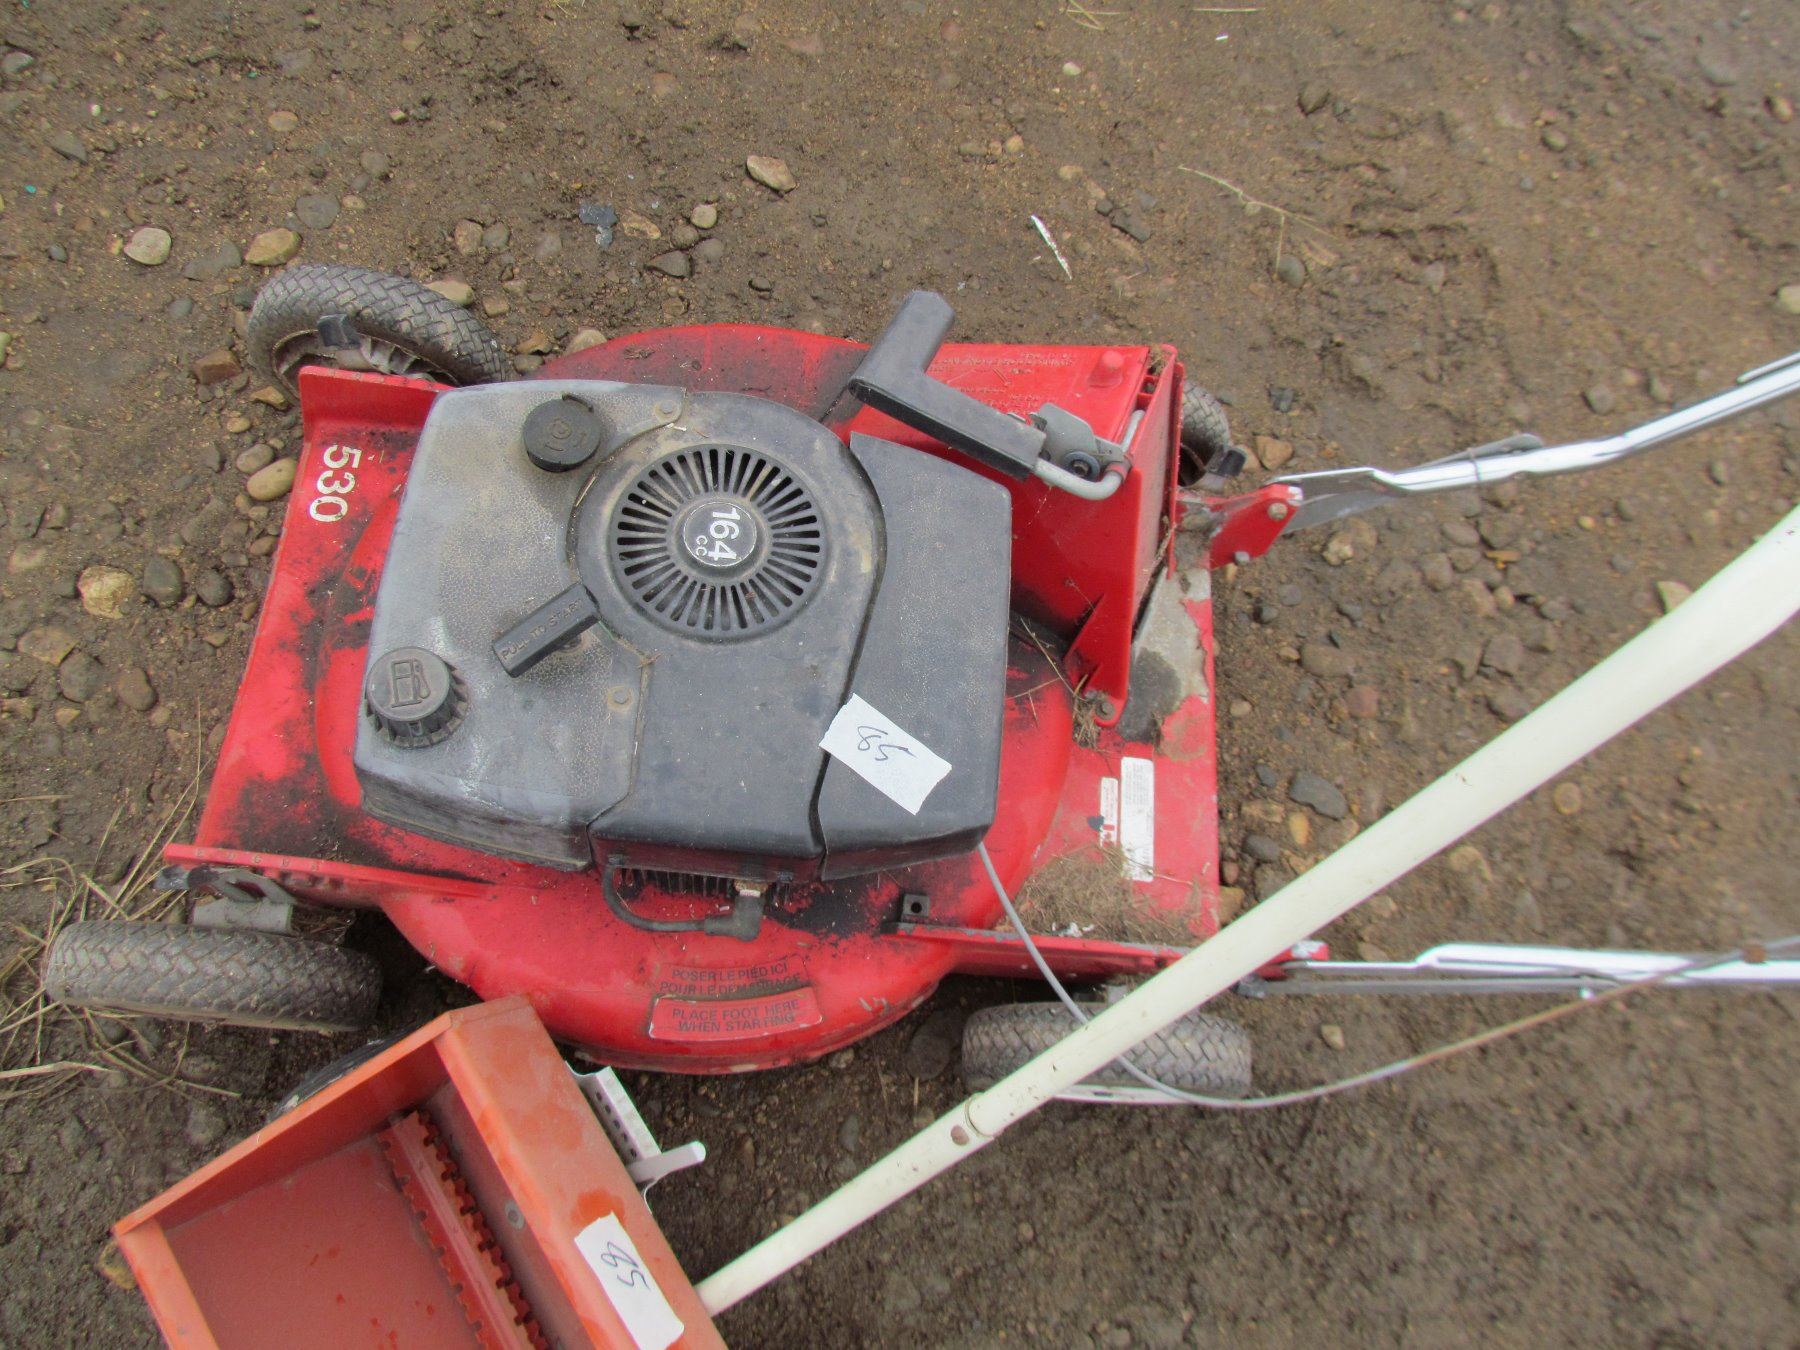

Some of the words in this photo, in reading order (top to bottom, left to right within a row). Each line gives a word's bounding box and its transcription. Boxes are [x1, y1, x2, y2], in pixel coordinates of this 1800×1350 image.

[309, 445, 362, 523] 530
[708, 507, 741, 561] 164
[501, 637, 531, 660] PULL
[530, 624, 547, 639] TO
[672, 969, 717, 981] POSER
[719, 969, 736, 980] LE
[770, 962, 788, 975] ICI
[660, 981, 697, 996] POUR
[672, 1008, 718, 1020] PLACE
[722, 1006, 759, 1021] FOOT
[764, 999, 799, 1016] HERE
[678, 1020, 720, 1033] WHEN
